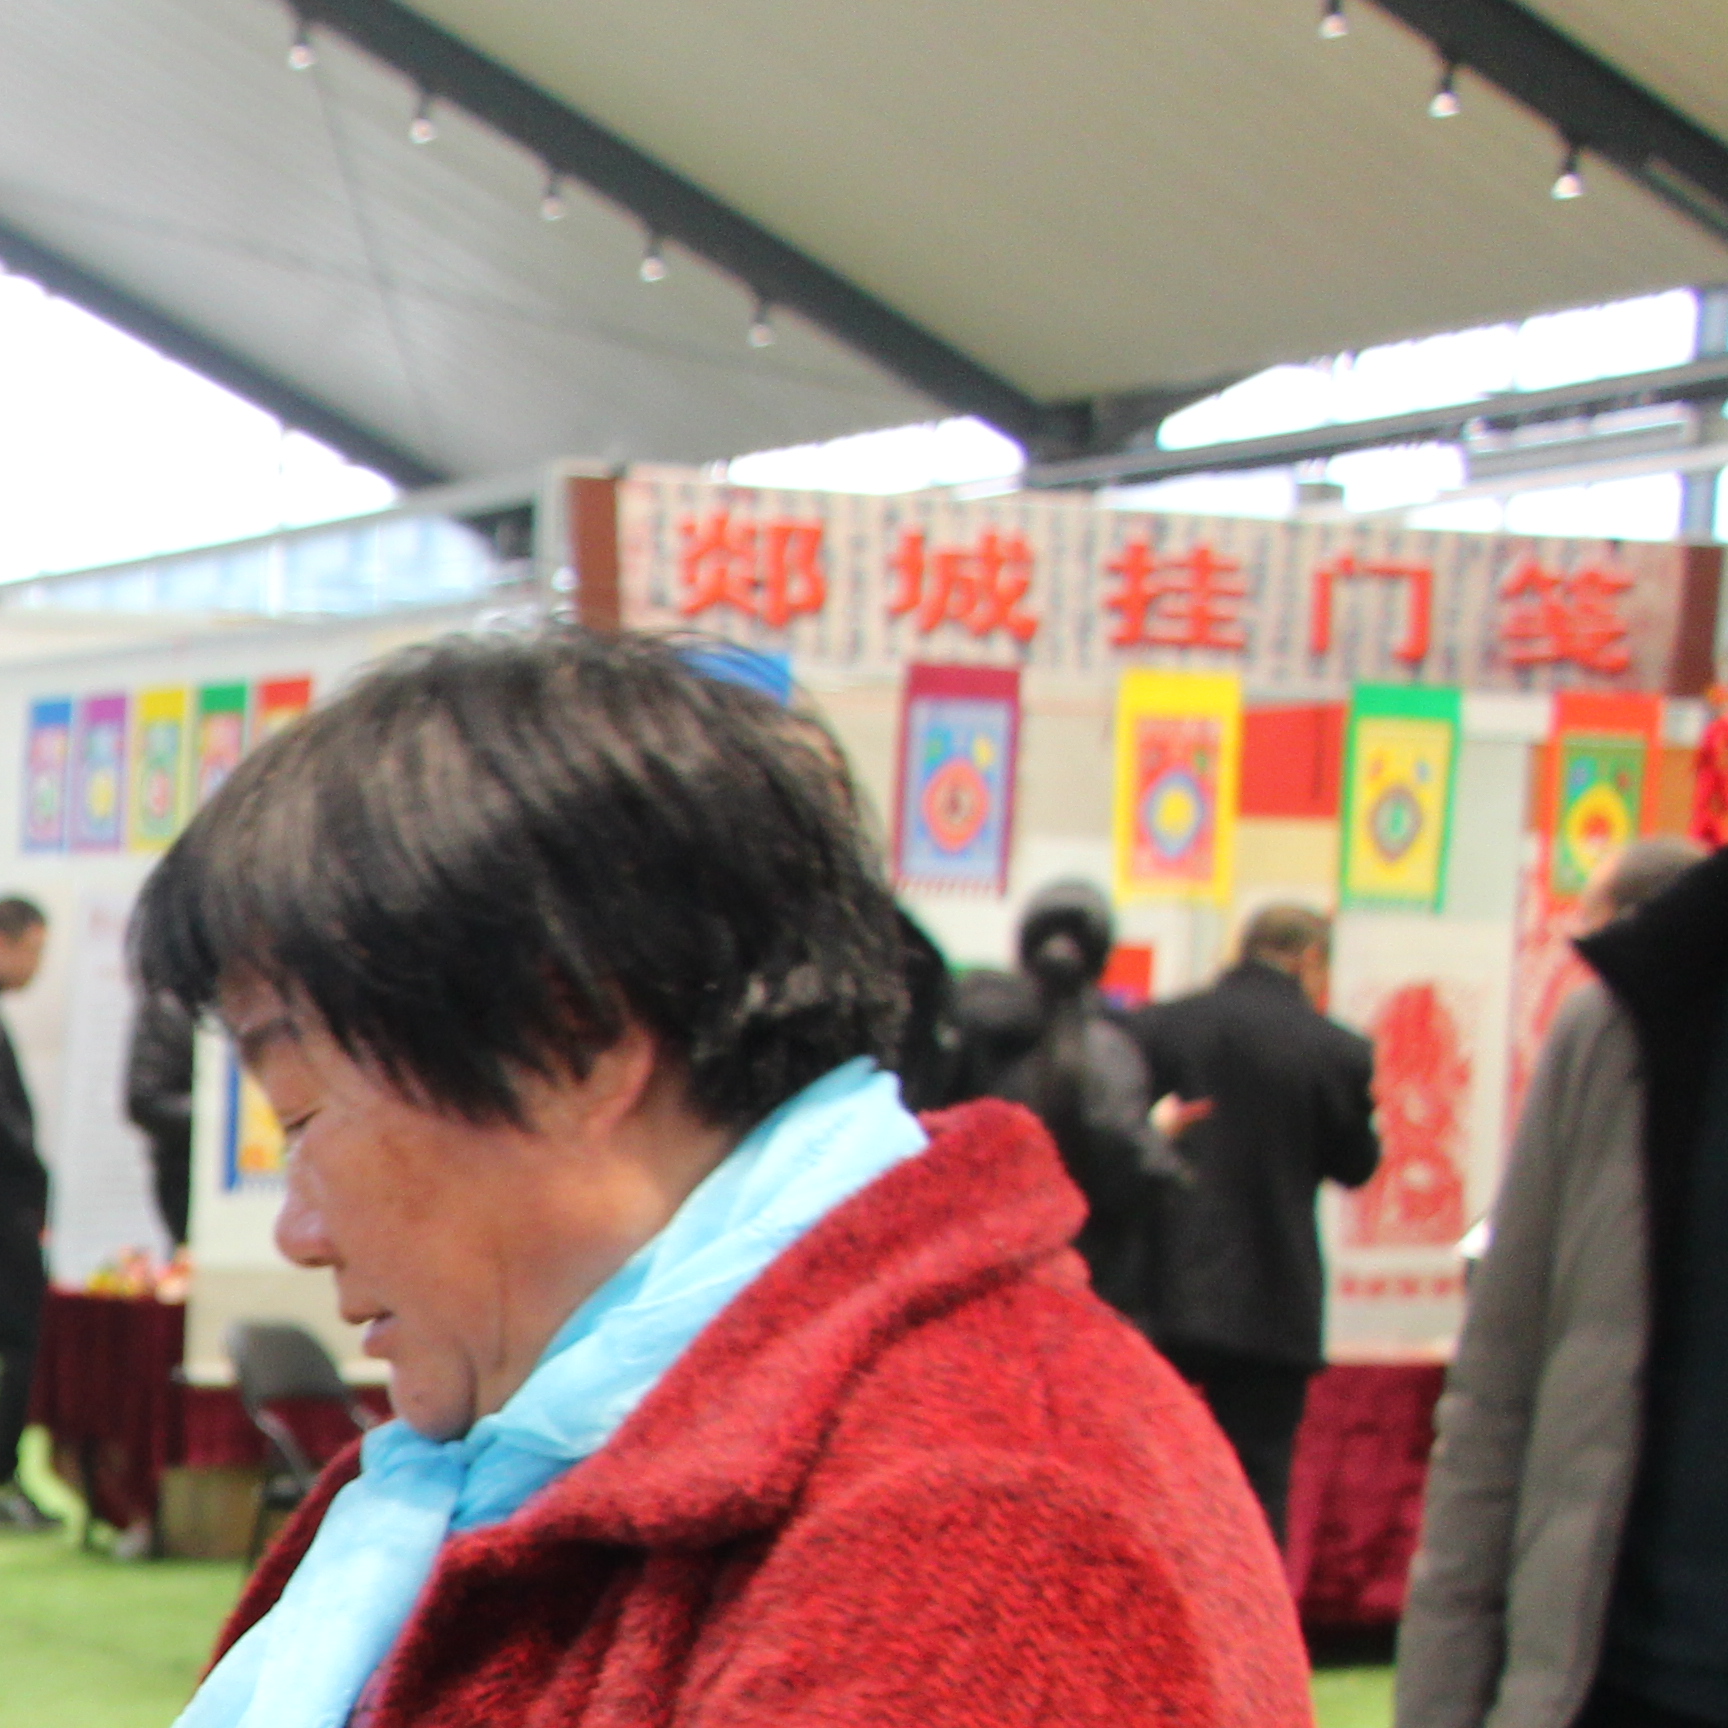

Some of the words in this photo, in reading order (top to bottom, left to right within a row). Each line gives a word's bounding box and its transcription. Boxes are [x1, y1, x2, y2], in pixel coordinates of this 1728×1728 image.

[680, 512, 1634, 674] 郯城挂门笺
